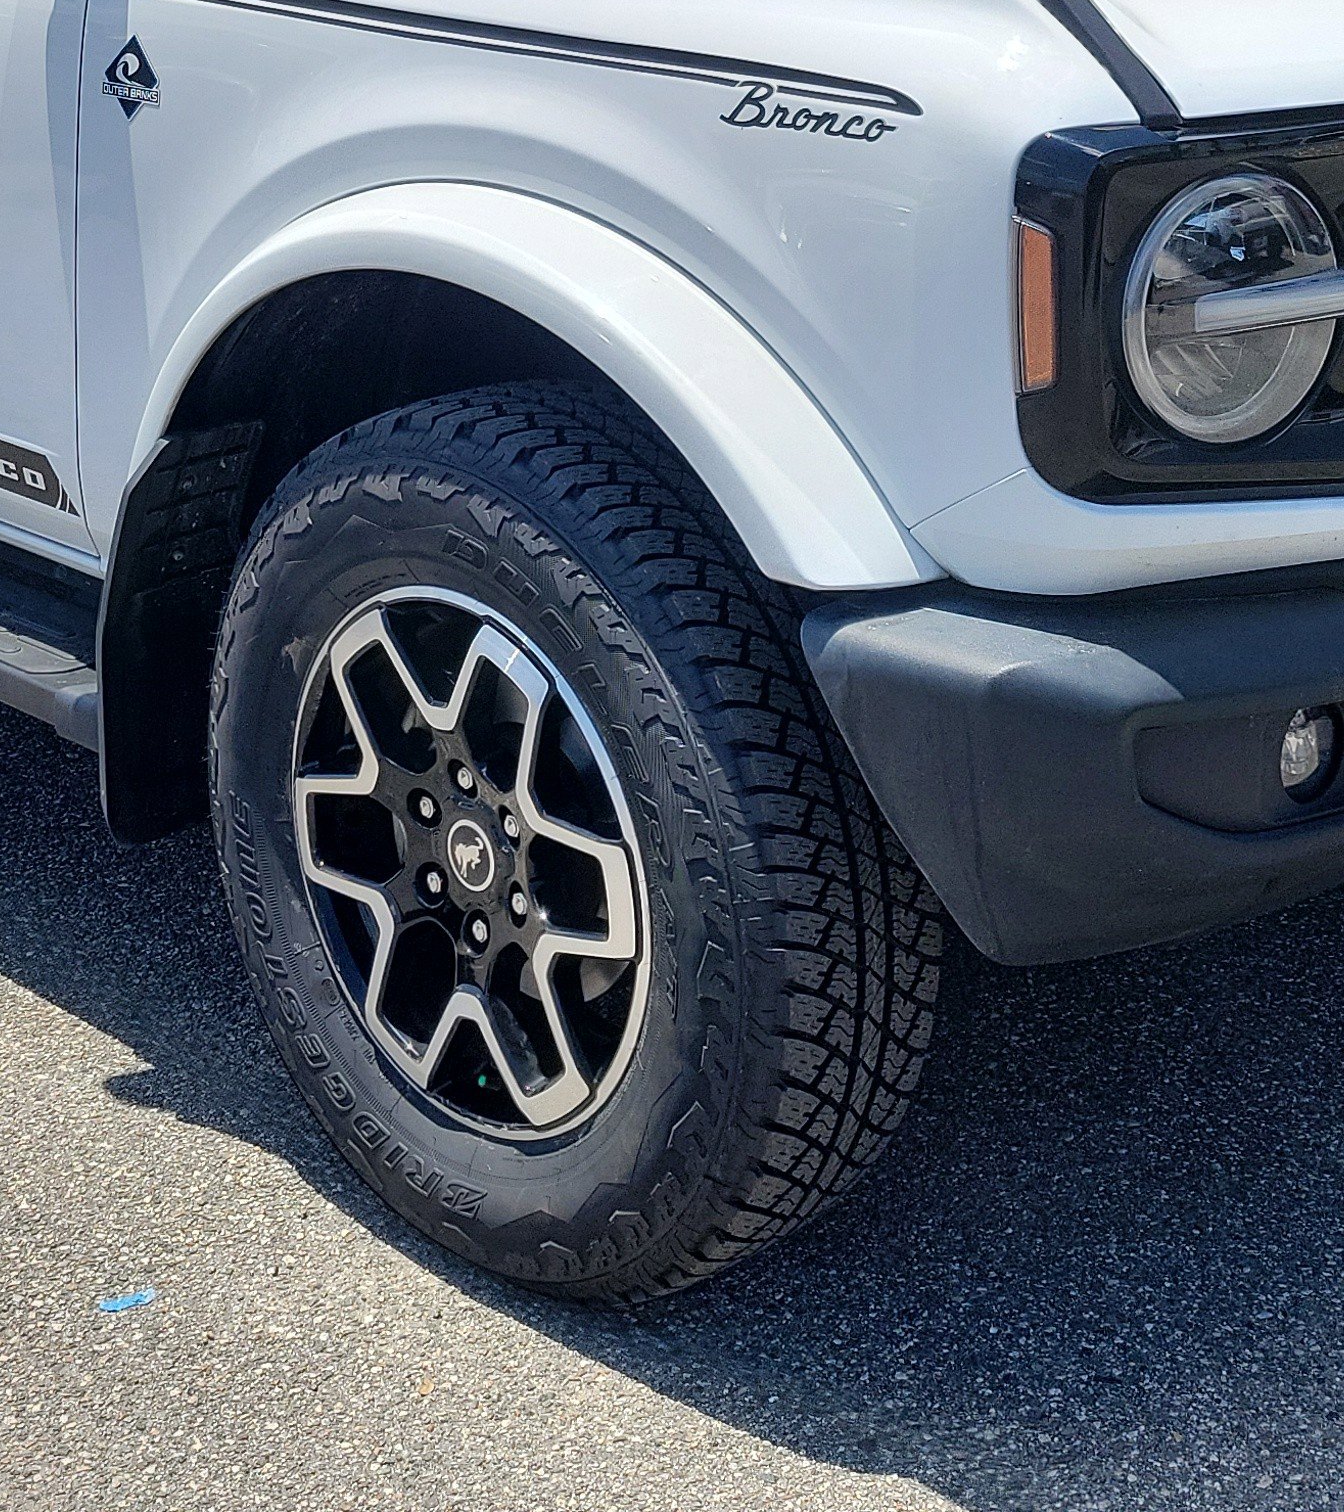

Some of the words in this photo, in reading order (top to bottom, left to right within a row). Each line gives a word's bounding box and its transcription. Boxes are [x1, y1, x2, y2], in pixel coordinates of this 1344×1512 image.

[103, 83, 130, 97] OUTER
[130, 88, 158, 102] BANKS
[719, 80, 898, 143] Bronco
[228, 789, 488, 1219] BRIDGESTONE
